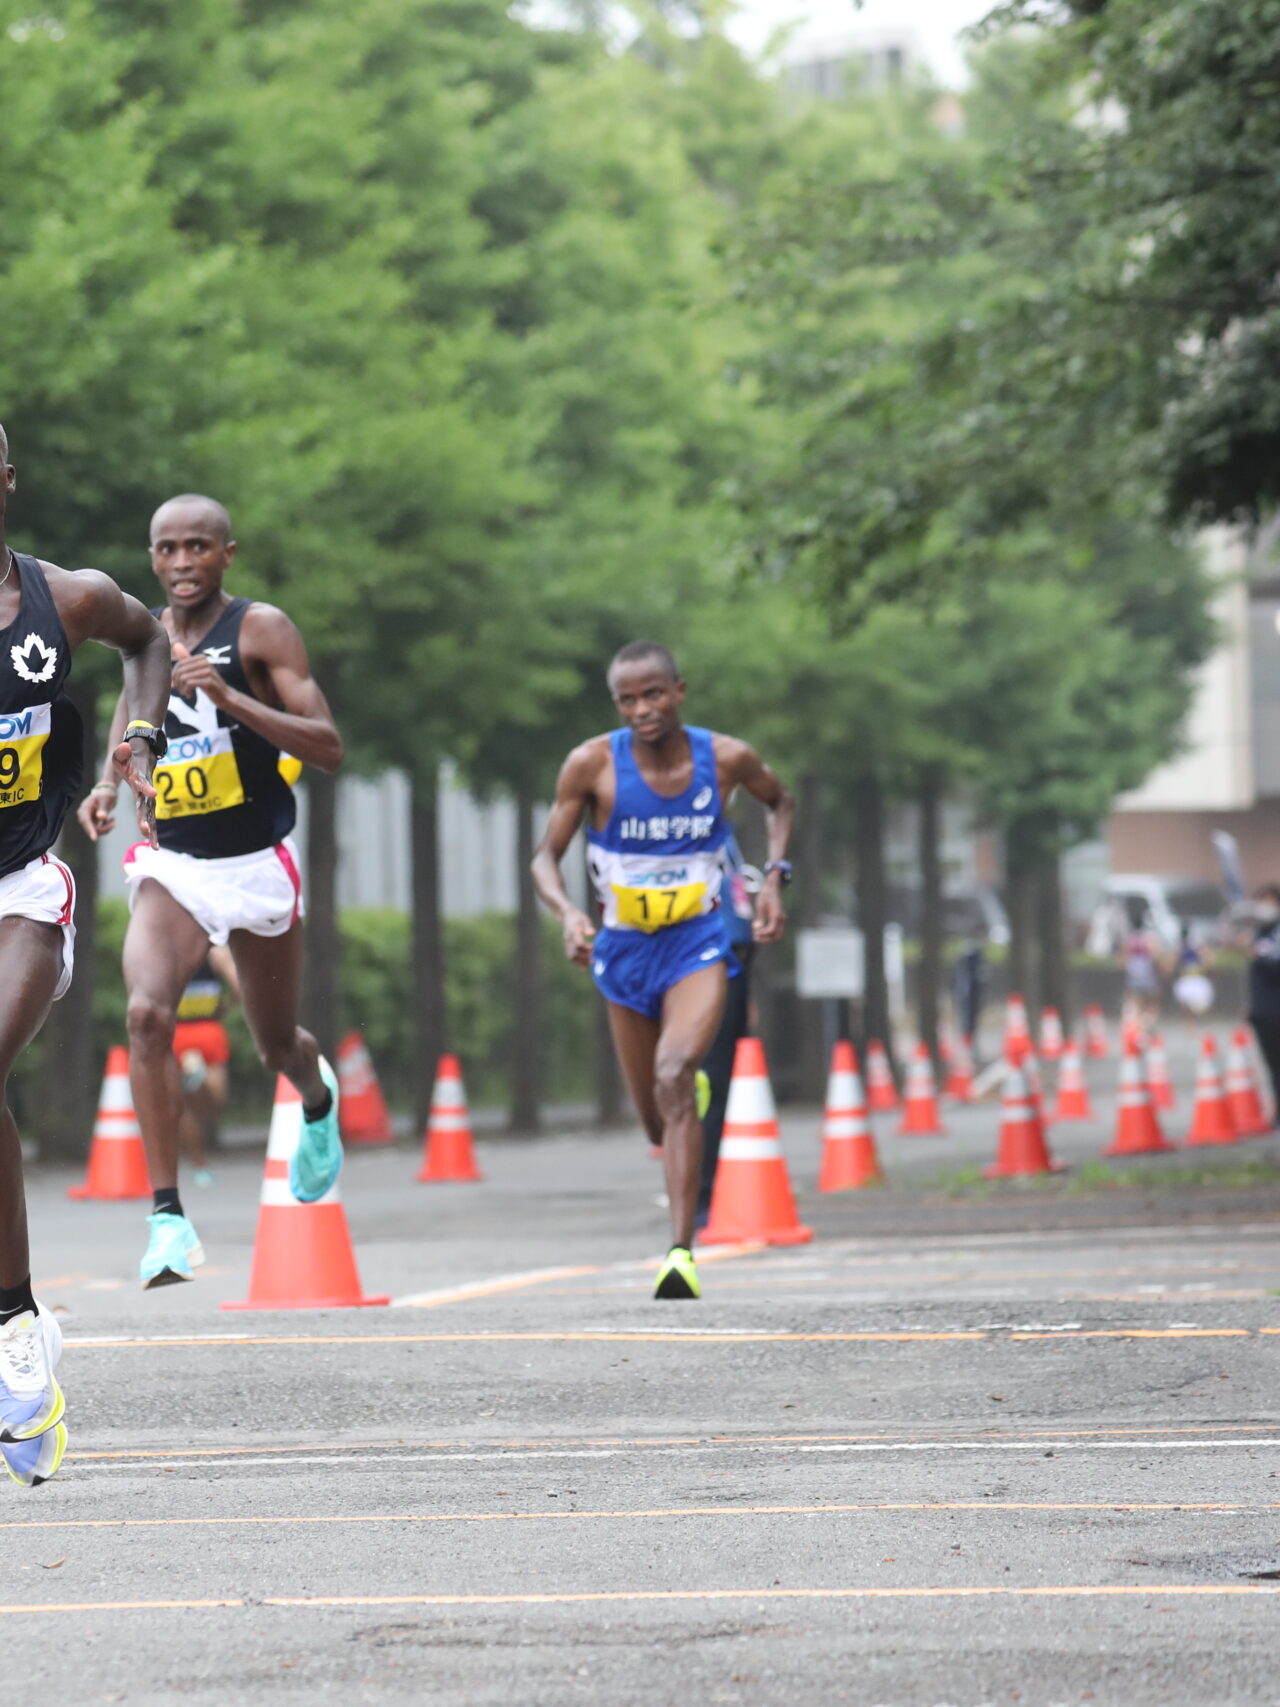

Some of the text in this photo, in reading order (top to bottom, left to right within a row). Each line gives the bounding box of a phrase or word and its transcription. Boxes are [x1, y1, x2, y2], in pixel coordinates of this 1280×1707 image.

[159, 736, 212, 762] COM
[156, 766, 208, 804] 20
[636, 892, 678, 920] 17
